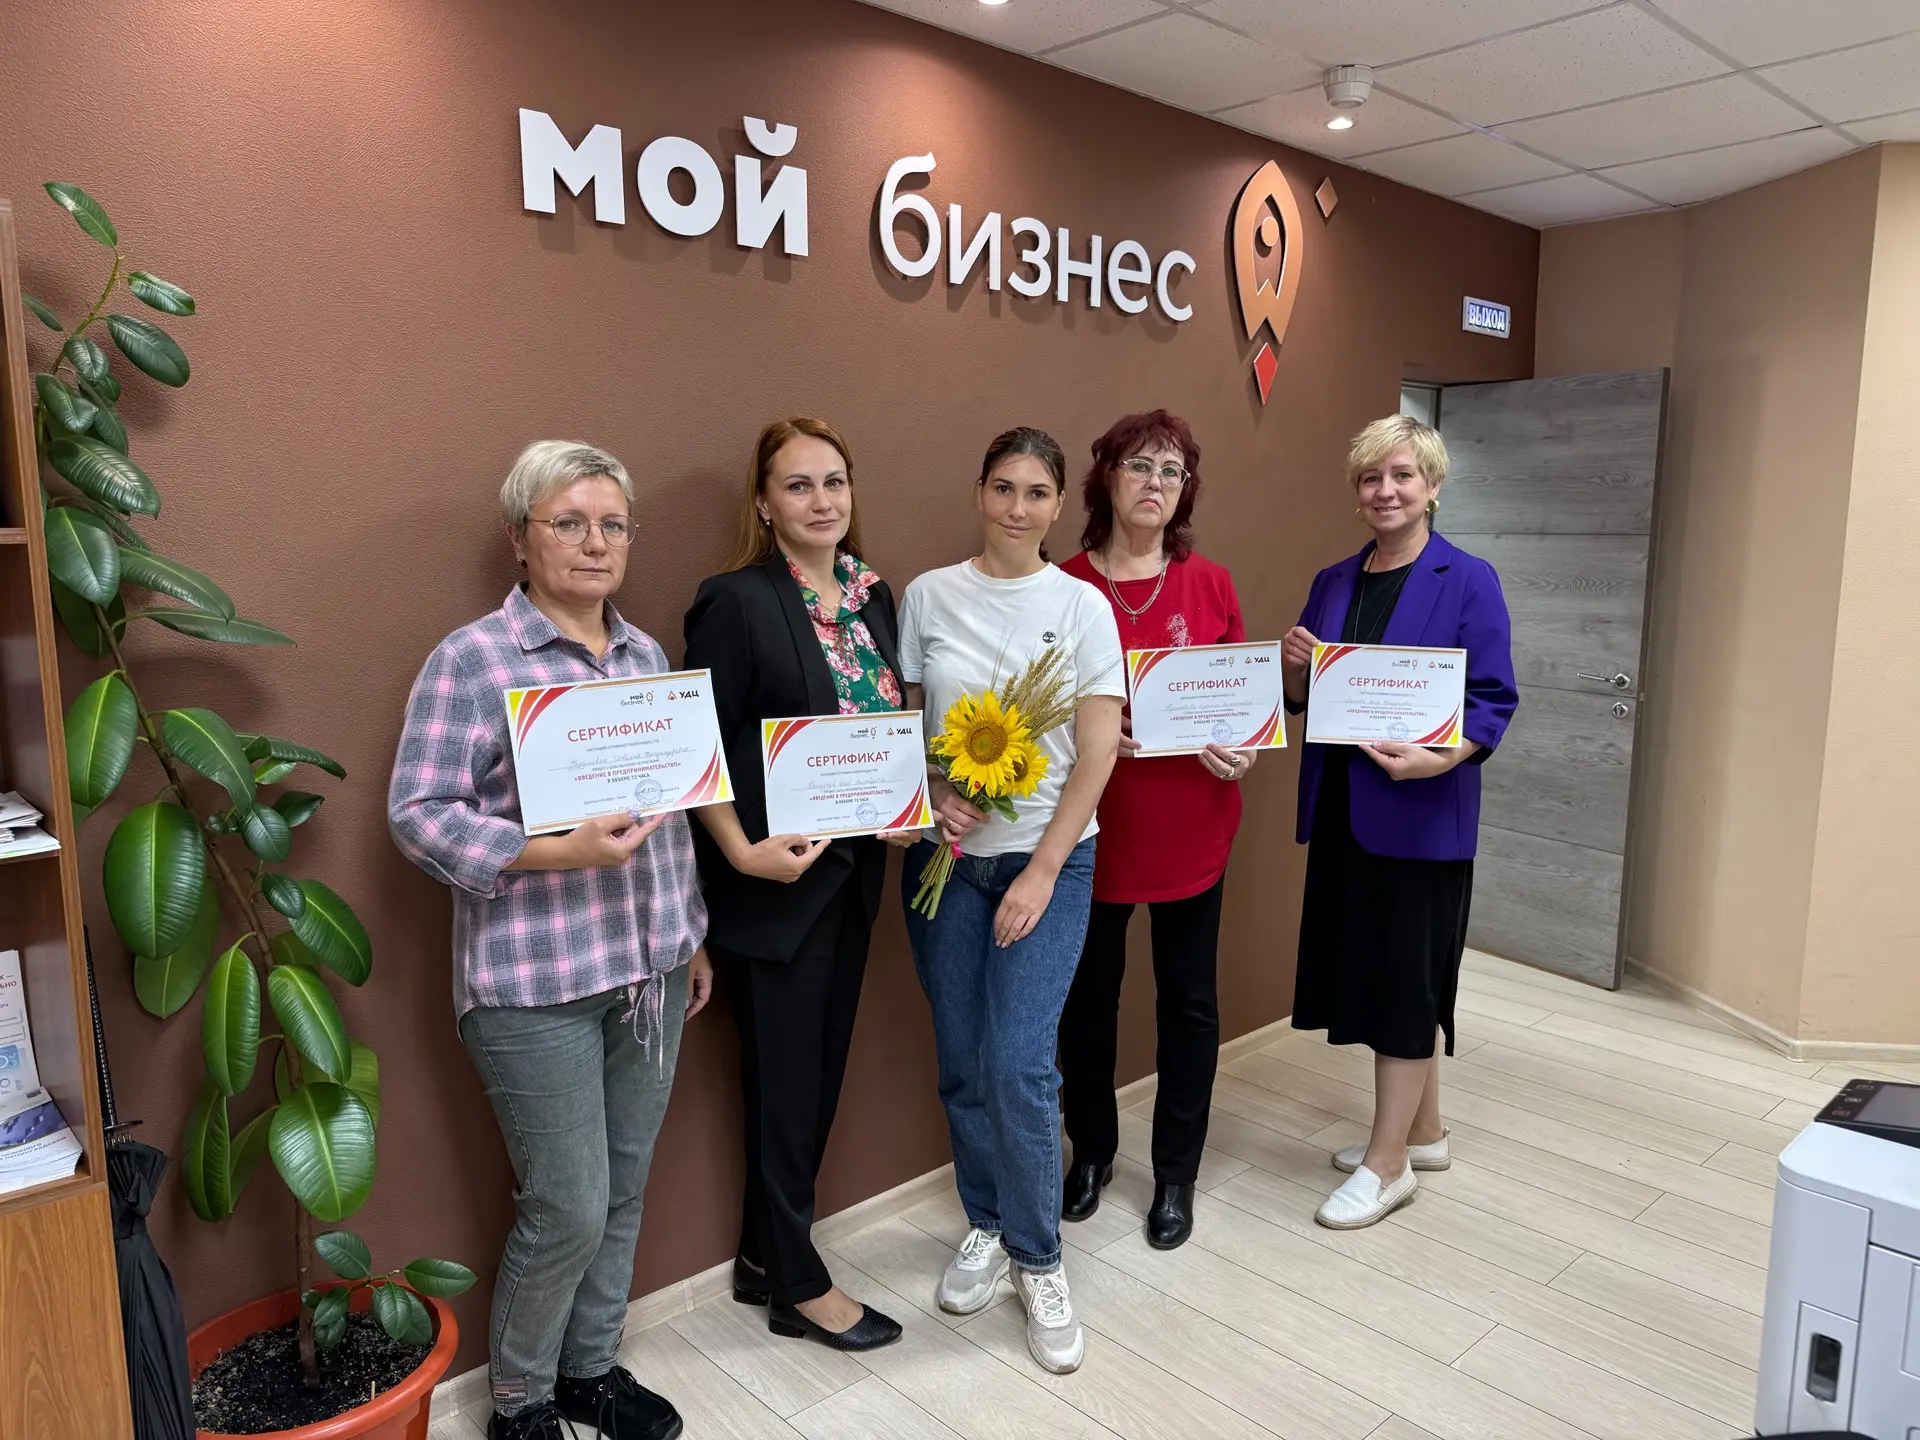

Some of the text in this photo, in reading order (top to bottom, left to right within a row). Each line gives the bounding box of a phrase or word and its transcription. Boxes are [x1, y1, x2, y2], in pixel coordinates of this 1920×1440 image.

[879, 152, 1196, 321] бизнес
[1468, 304, 1505, 330] ВЫХОД
[1168, 677, 1247, 692] СЕРТИФИКАТ
[1348, 677, 1429, 689] СЕРТИФИКАТ
[679, 689, 699, 699] УДЦ
[567, 718, 673, 743] СЕРТИФИКАТ
[806, 751, 890, 767] СЕРТИФИКАТ
